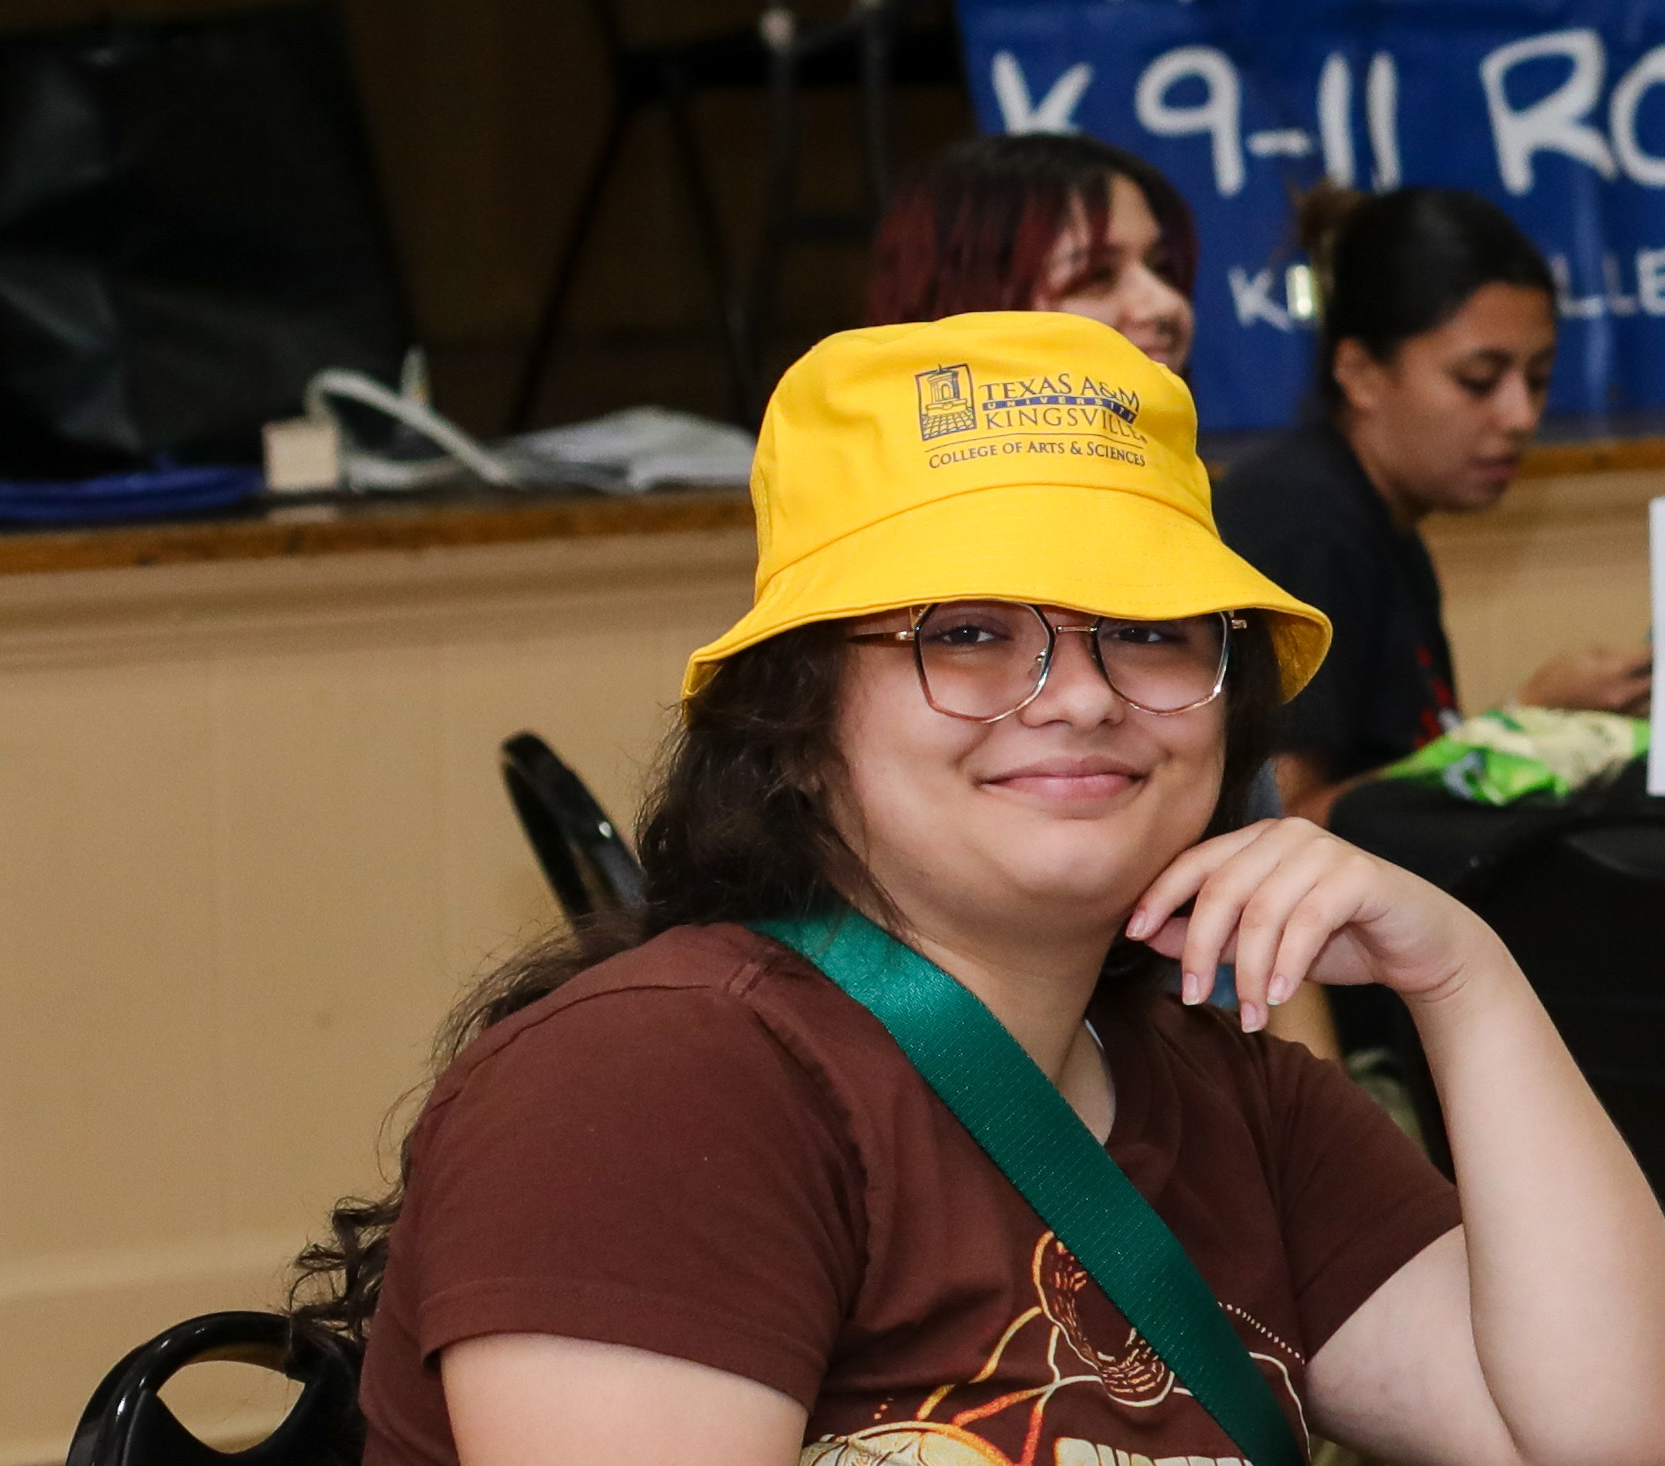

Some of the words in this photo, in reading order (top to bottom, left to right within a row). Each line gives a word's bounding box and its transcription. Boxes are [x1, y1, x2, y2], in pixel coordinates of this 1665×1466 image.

[978, 373, 1073, 401] TEXAS
[1080, 375, 1140, 414] A&M
[986, 395, 1135, 422] UNIVERSITY
[929, 443, 998, 469] COLLEGE
[1002, 441, 1023, 455] OF
[1026, 440, 1065, 455] ARTS
[1070, 440, 1083, 455] &
[1087, 441, 1146, 468] SCIENCES
